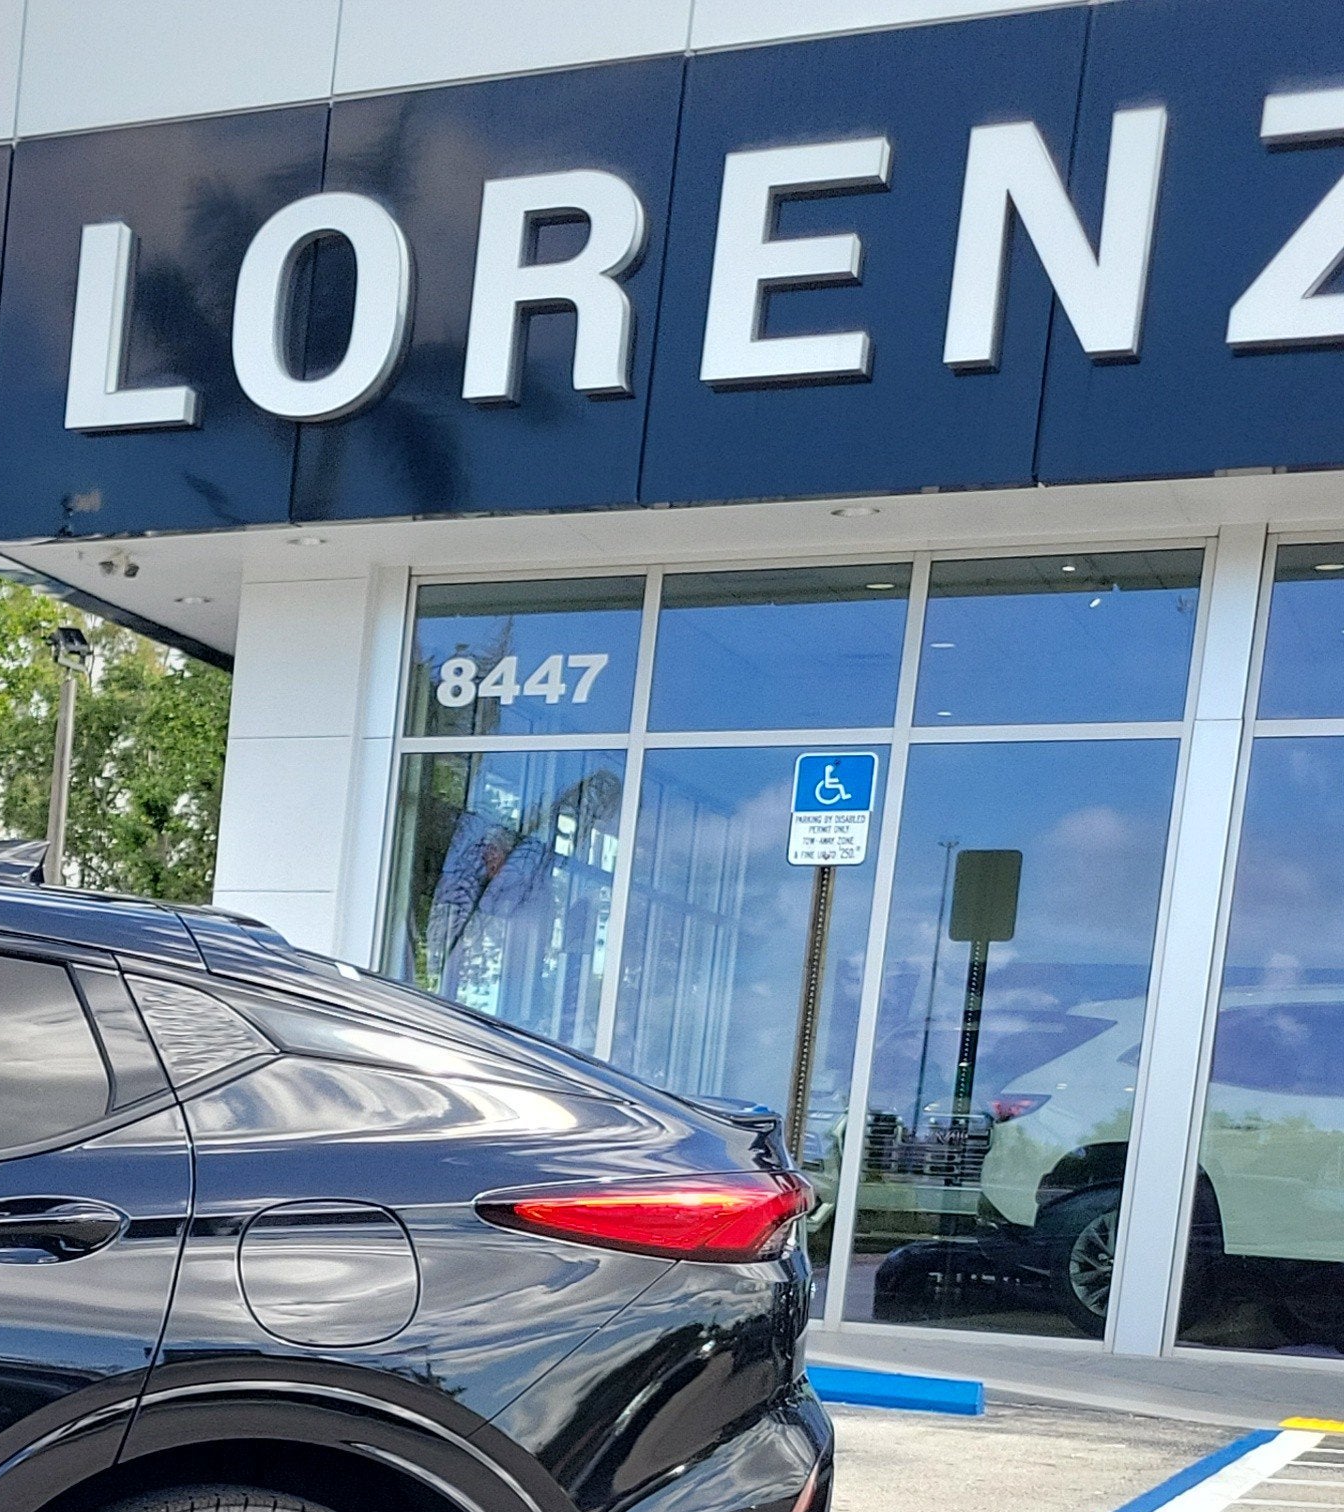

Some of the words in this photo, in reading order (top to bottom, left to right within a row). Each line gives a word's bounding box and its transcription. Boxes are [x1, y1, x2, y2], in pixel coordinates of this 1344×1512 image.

[65, 89, 1344, 430] LORENZ
[437, 654, 609, 707] 8447
[795, 815, 822, 824] PARKING
[824, 815, 832, 824] BY
[834, 814, 866, 824] DISABLED
[808, 825, 831, 834] PERMIT
[833, 825, 850, 834] ONLY
[837, 836, 854, 845] ZONE
